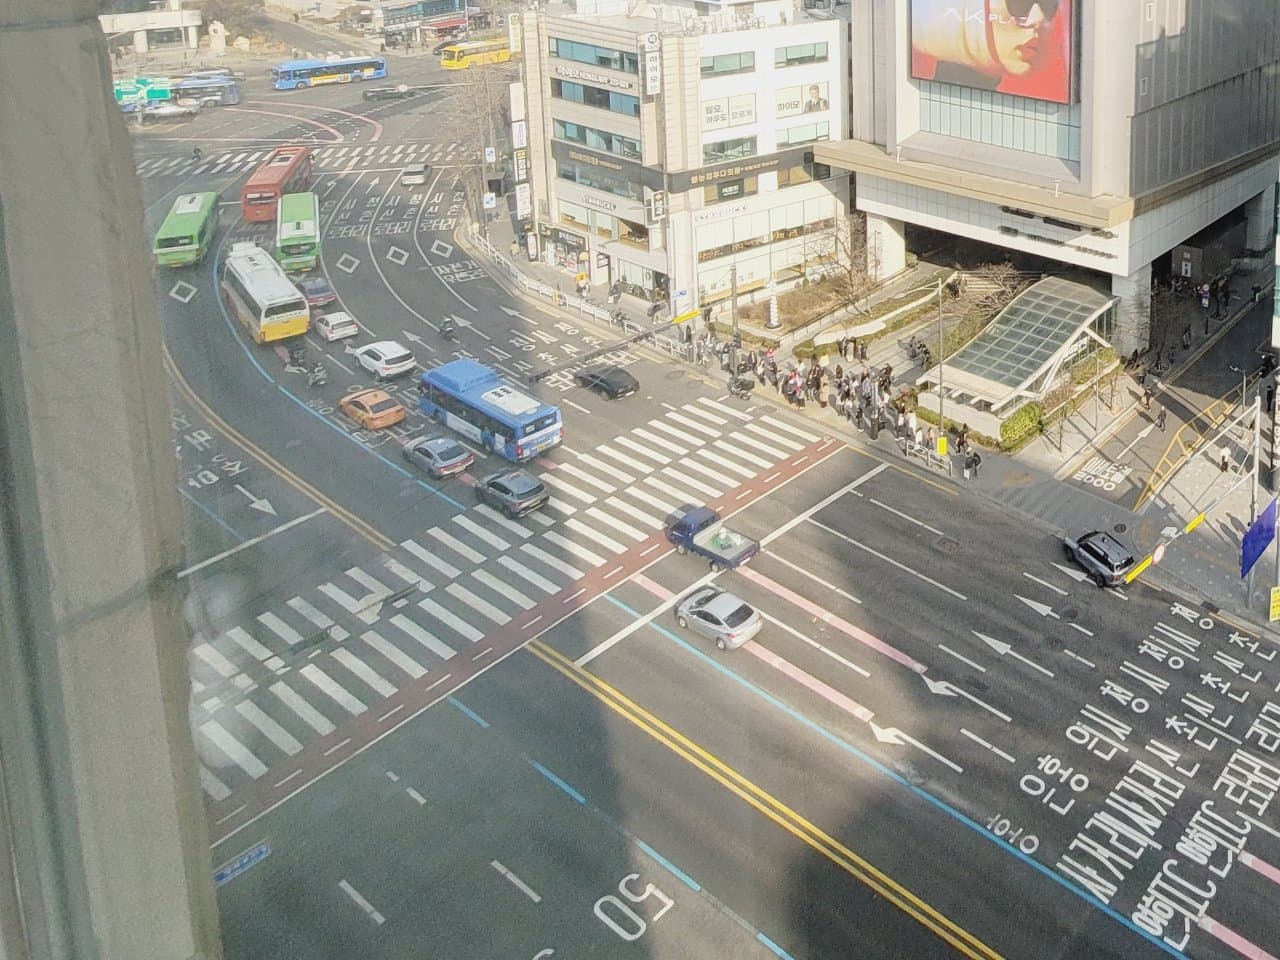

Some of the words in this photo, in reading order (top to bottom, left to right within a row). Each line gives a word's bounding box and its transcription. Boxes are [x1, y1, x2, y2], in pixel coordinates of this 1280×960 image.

[777, 100, 800, 112] 하이모
[1154, 602, 1214, 647] 시청
[1120, 640, 1183, 693] 시청
[1213, 632, 1276, 681] 신촌
[1080, 680, 1150, 734] 시청
[1181, 673, 1248, 727] 신촌
[1037, 726, 1117, 791] 홍은
[1145, 715, 1217, 777] 신촌
[987, 774, 1074, 853] 홍은
[1106, 760, 1184, 833] 사거리
[1057, 813, 1150, 903] 사거리
[1176, 800, 1260, 876] 연희IC
[593, 873, 675, 941] 50
[1132, 859, 1215, 950] 연희IC
